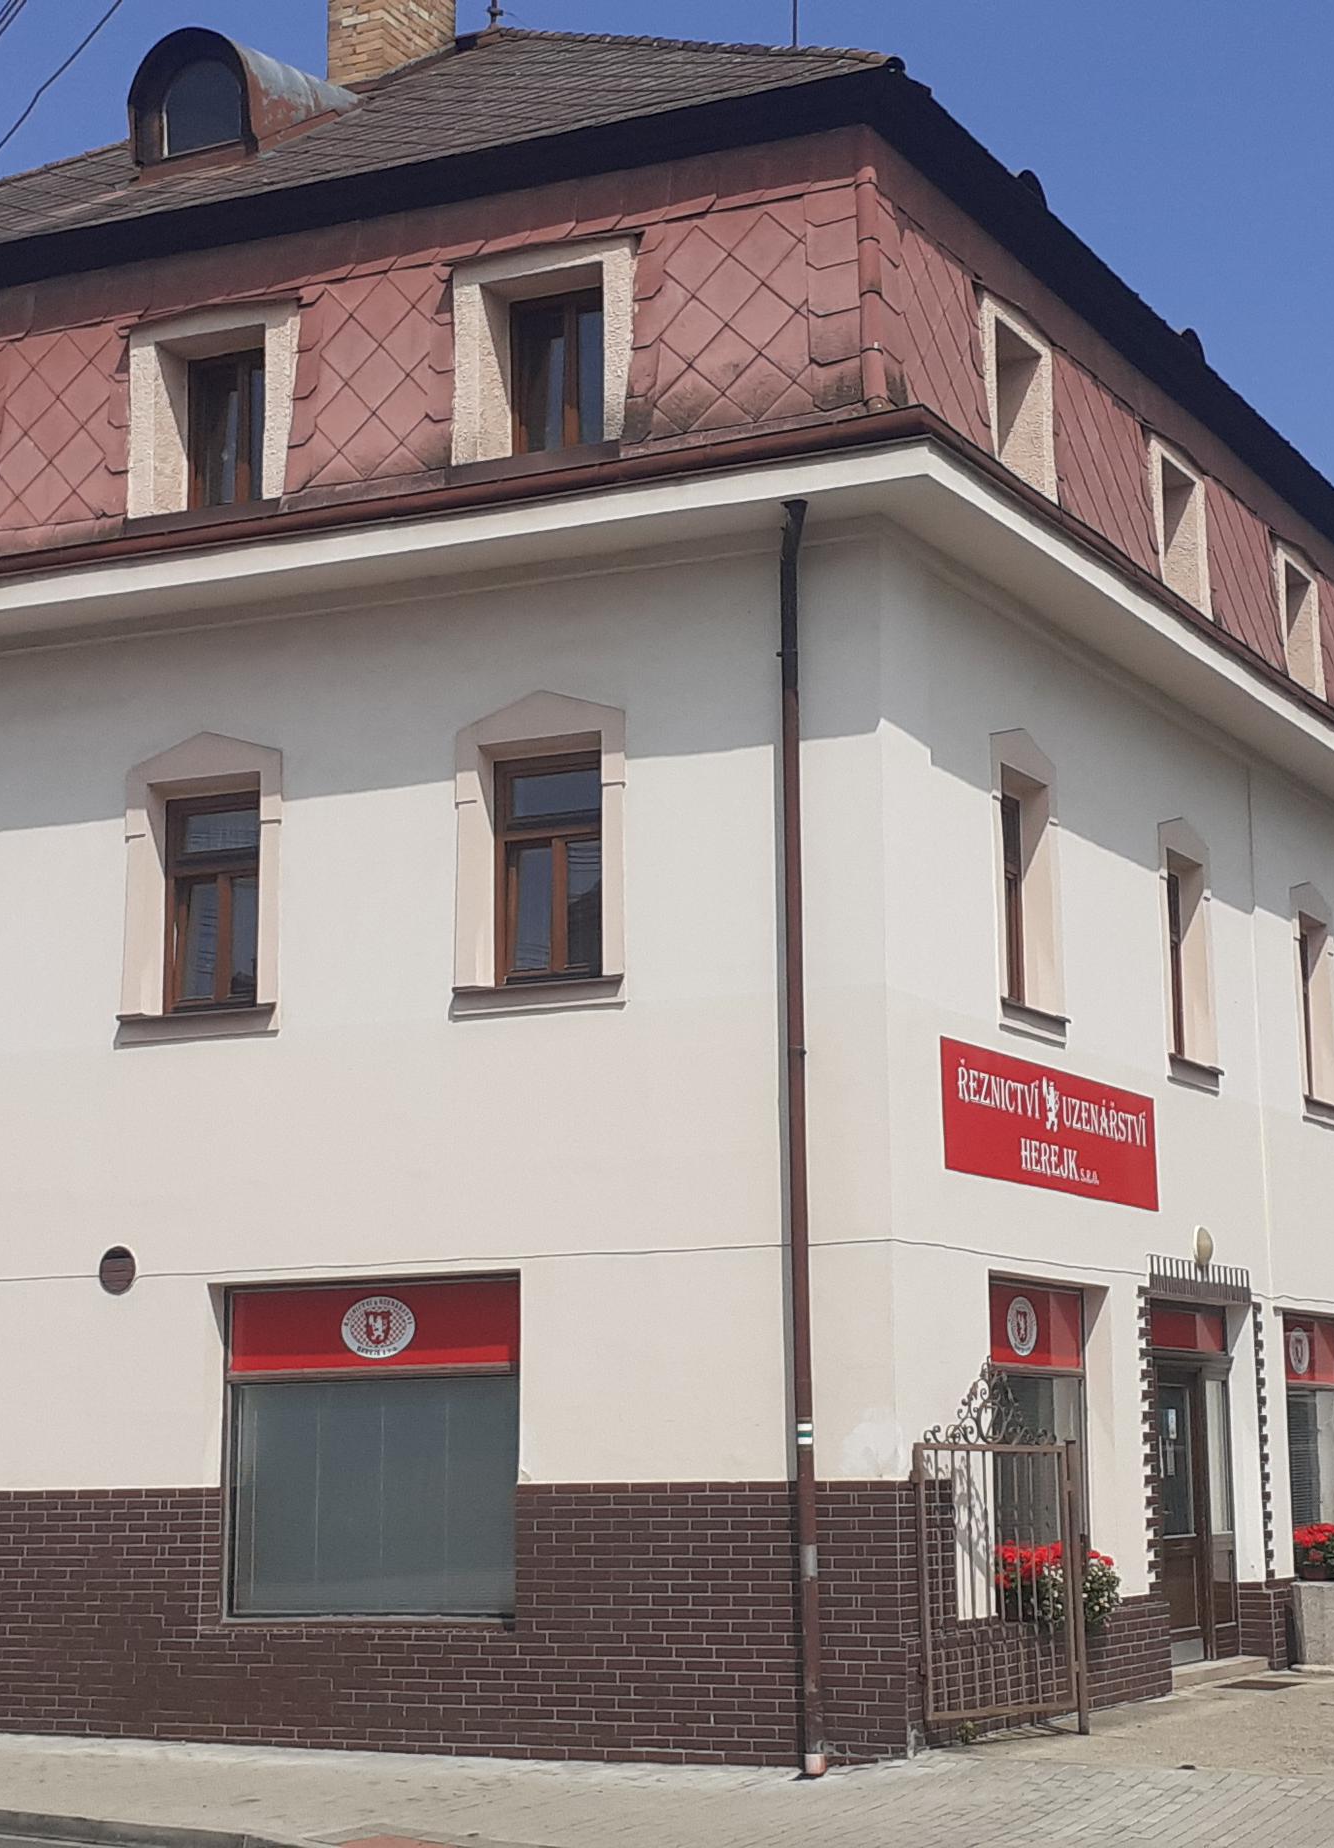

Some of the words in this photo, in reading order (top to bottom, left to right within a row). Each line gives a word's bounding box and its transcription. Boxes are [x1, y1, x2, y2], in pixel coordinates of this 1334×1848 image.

[956, 1056, 1041, 1120] ŘEZNICTVÍ
[1061, 1096, 1147, 1148] UZENÁŘSTVÍ
[1020, 1137, 1080, 1182] HEREJK
